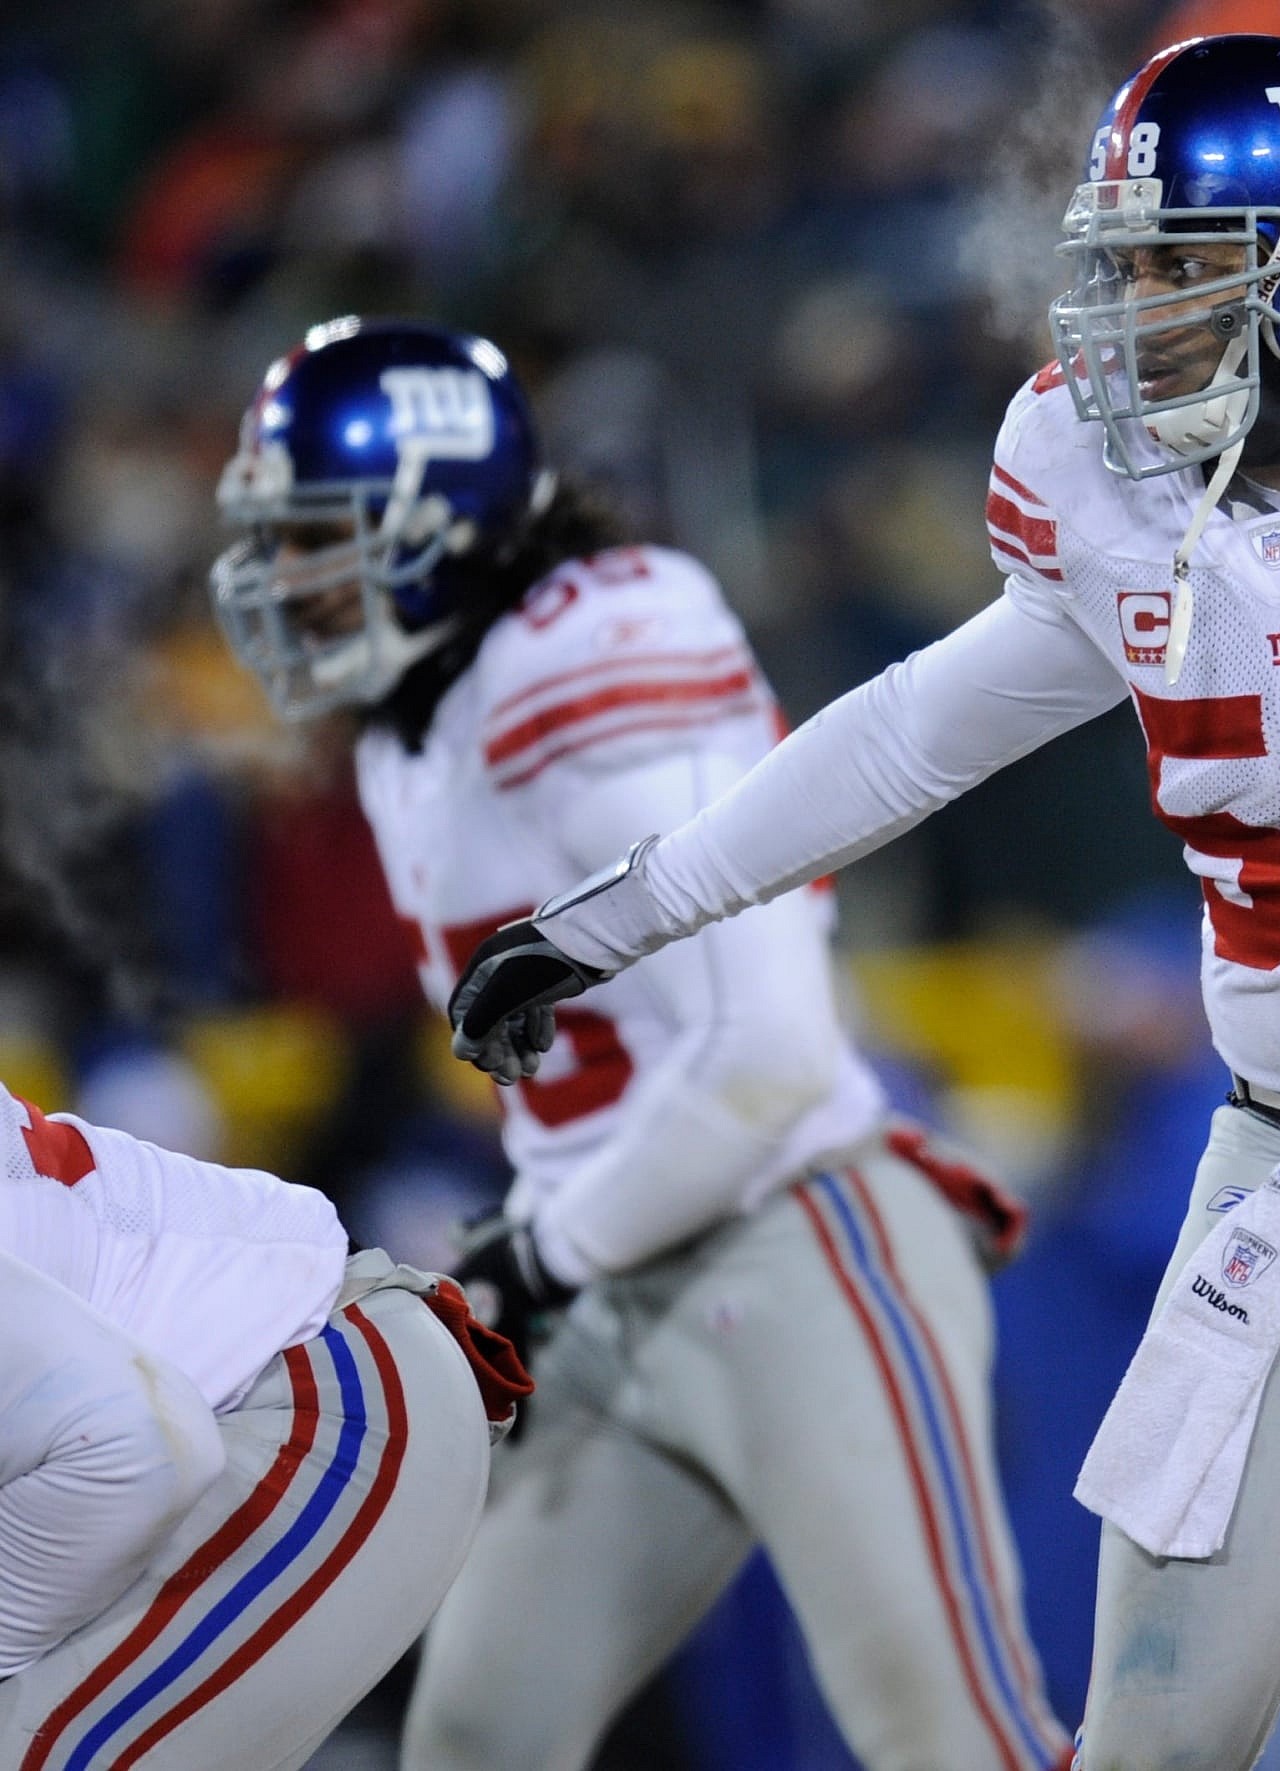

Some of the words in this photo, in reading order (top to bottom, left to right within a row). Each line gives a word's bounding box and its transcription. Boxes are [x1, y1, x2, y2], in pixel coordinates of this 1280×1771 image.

[1090, 122, 1161, 181] 58
[1119, 595, 1170, 649] C
[1192, 1275, 1250, 1324] Wilson
